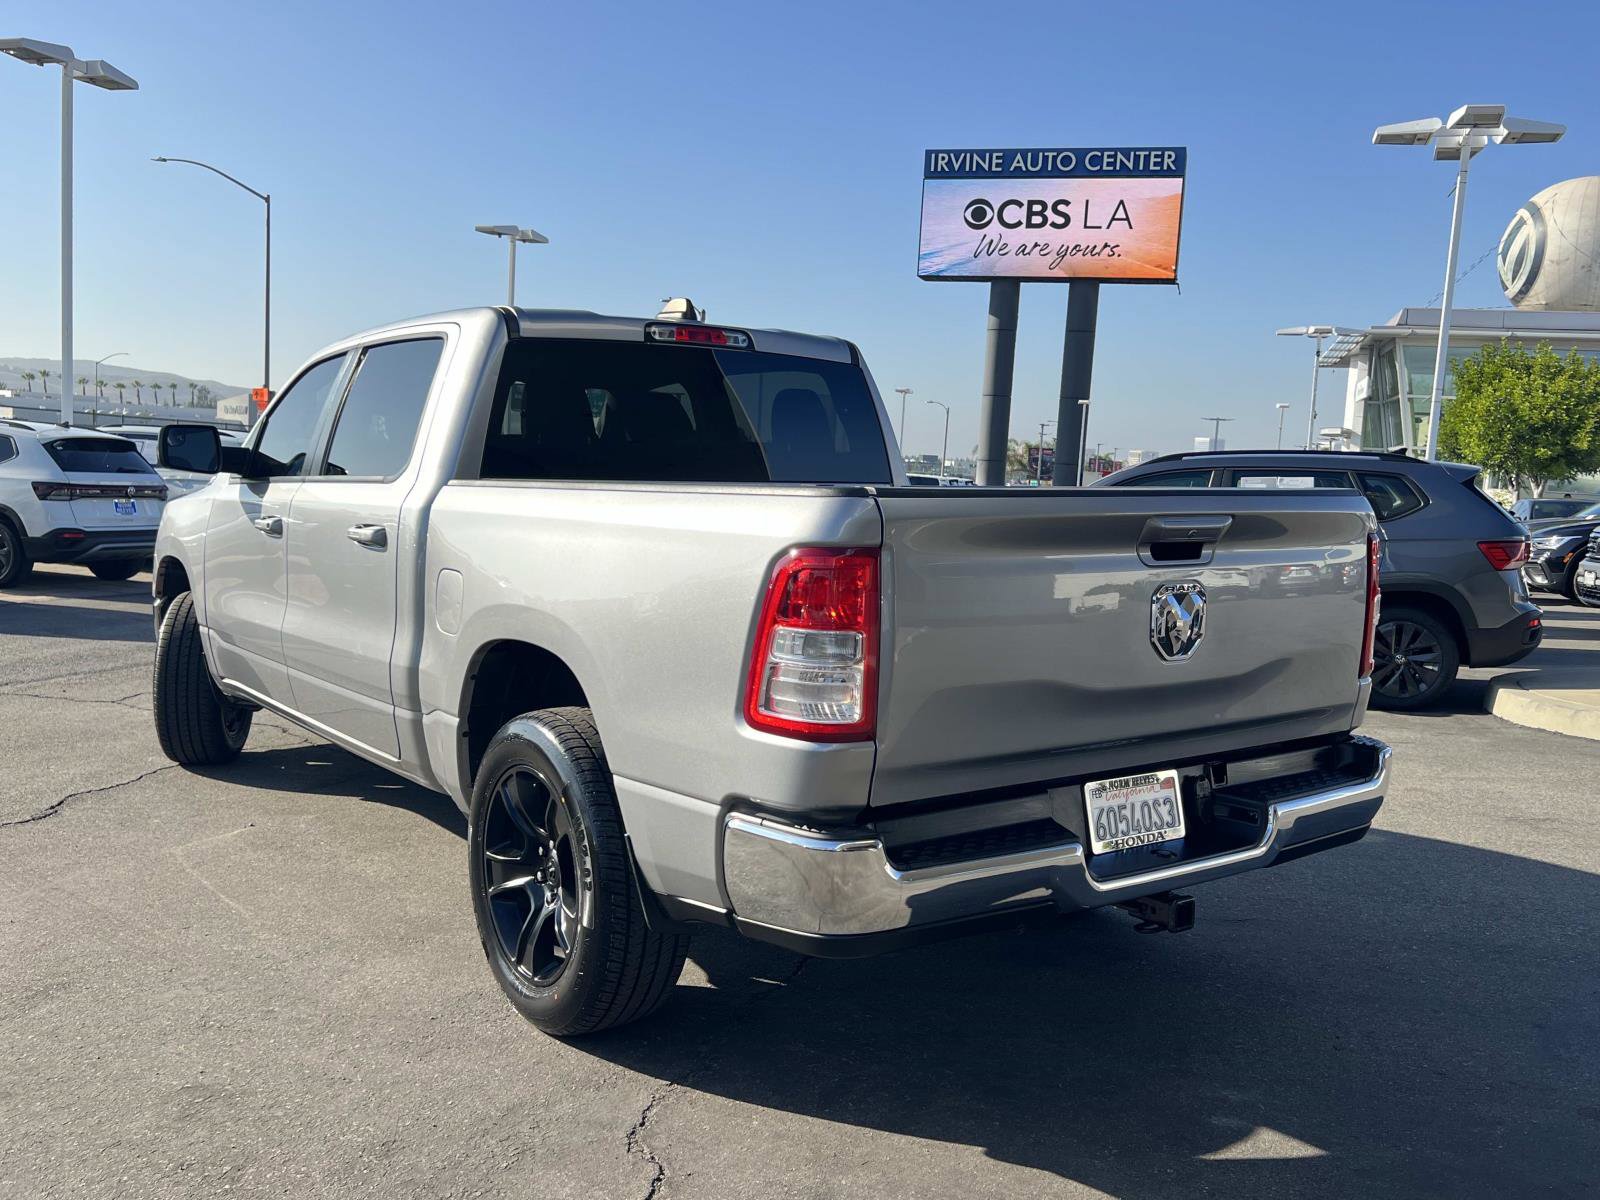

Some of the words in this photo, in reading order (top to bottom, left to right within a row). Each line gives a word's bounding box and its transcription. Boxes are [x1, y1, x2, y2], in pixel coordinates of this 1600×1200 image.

[929, 152, 1003, 172] IRVINE
[1009, 151, 1077, 171] AUTO
[1084, 151, 1177, 171] CENTER
[997, 198, 1072, 230] CBS
[1083, 199, 1134, 230] LA
[973, 233, 1011, 259] We
[1014, 243, 1051, 257] are
[1048, 243, 1122, 271] yours.
[1166, 584, 1201, 593] RAM
[1108, 777, 1130, 791] NORM
[1115, 832, 1166, 849] HONDA
